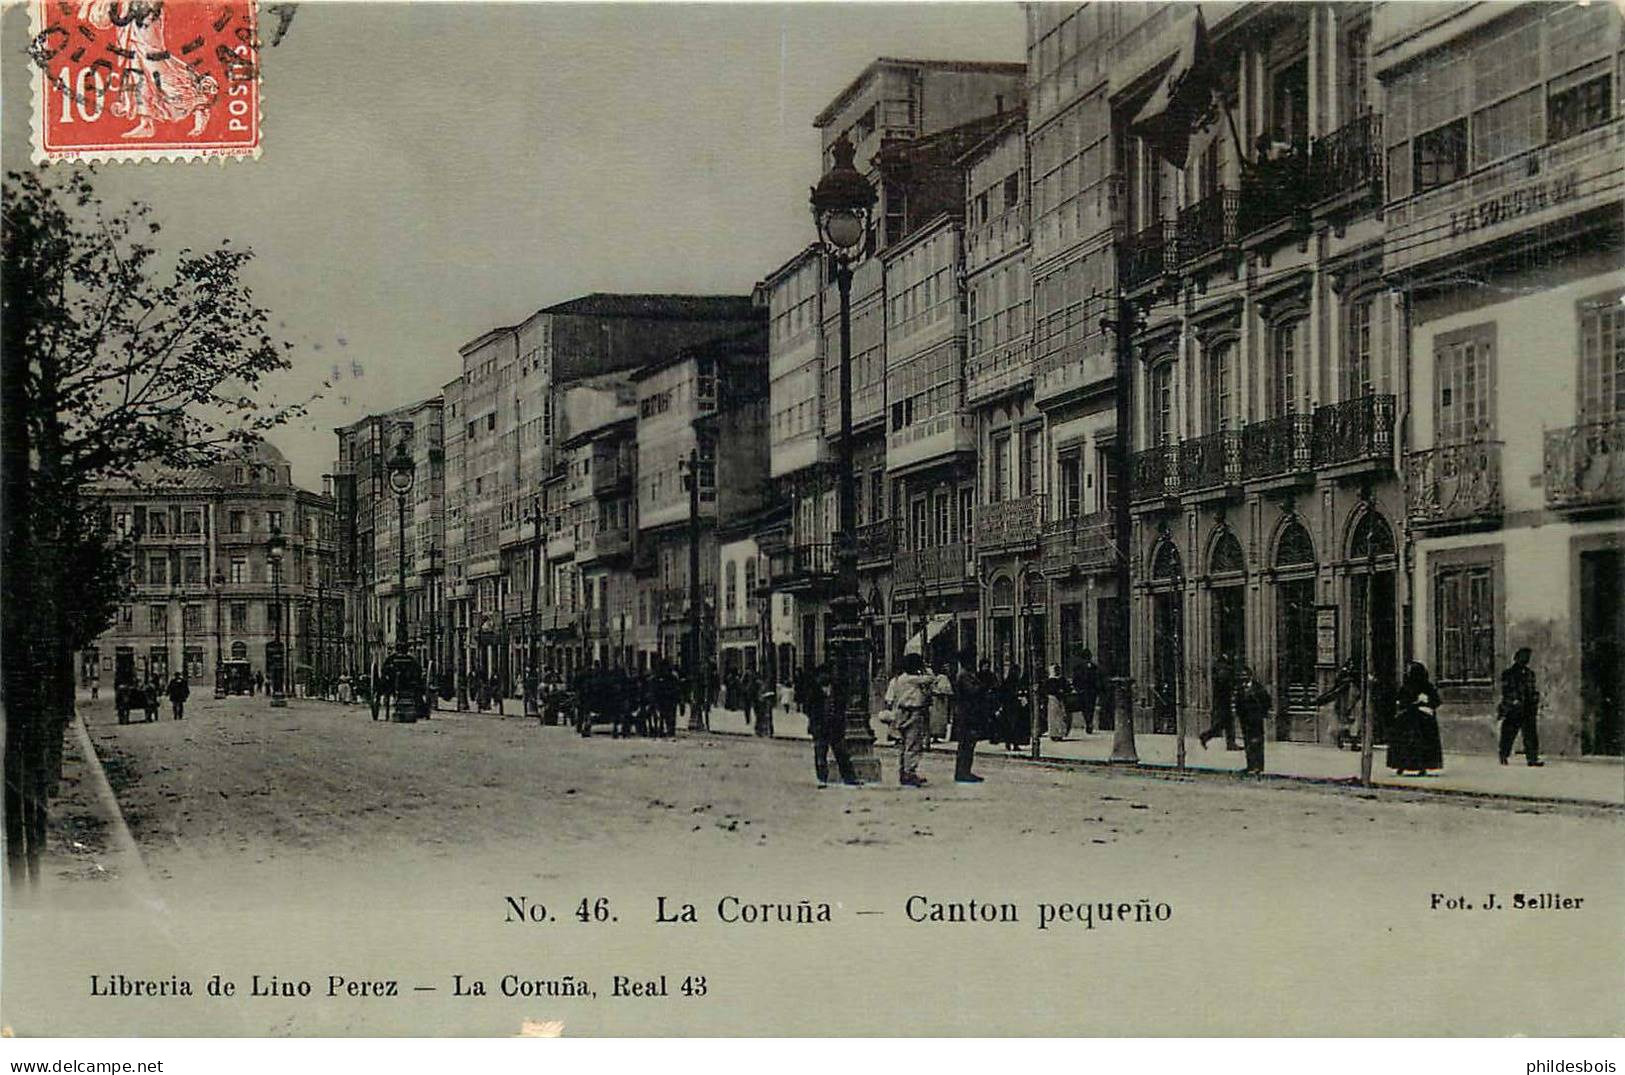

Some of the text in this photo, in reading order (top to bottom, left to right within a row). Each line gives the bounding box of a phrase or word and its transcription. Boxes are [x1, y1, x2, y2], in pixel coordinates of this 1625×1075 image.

[228, 43, 249, 132] POSTS
[505, 896, 556, 922] No.
[575, 897, 618, 923] 46.
[655, 896, 698, 923] La
[717, 896, 831, 924] Coruña
[905, 895, 1019, 923] Canton
[1038, 898, 1172, 930] pequeño
[1431, 893, 1584, 910] Fot. J. Sellier
[90, 974, 193, 997] Libreria
[207, 975, 235, 997] de
[251, 975, 311, 997] Lino
[327, 975, 398, 997] Perez
[453, 975, 487, 996] La
[500, 974, 597, 999] Coruña,
[612, 975, 668, 997] Real
[680, 975, 707, 997] 43
